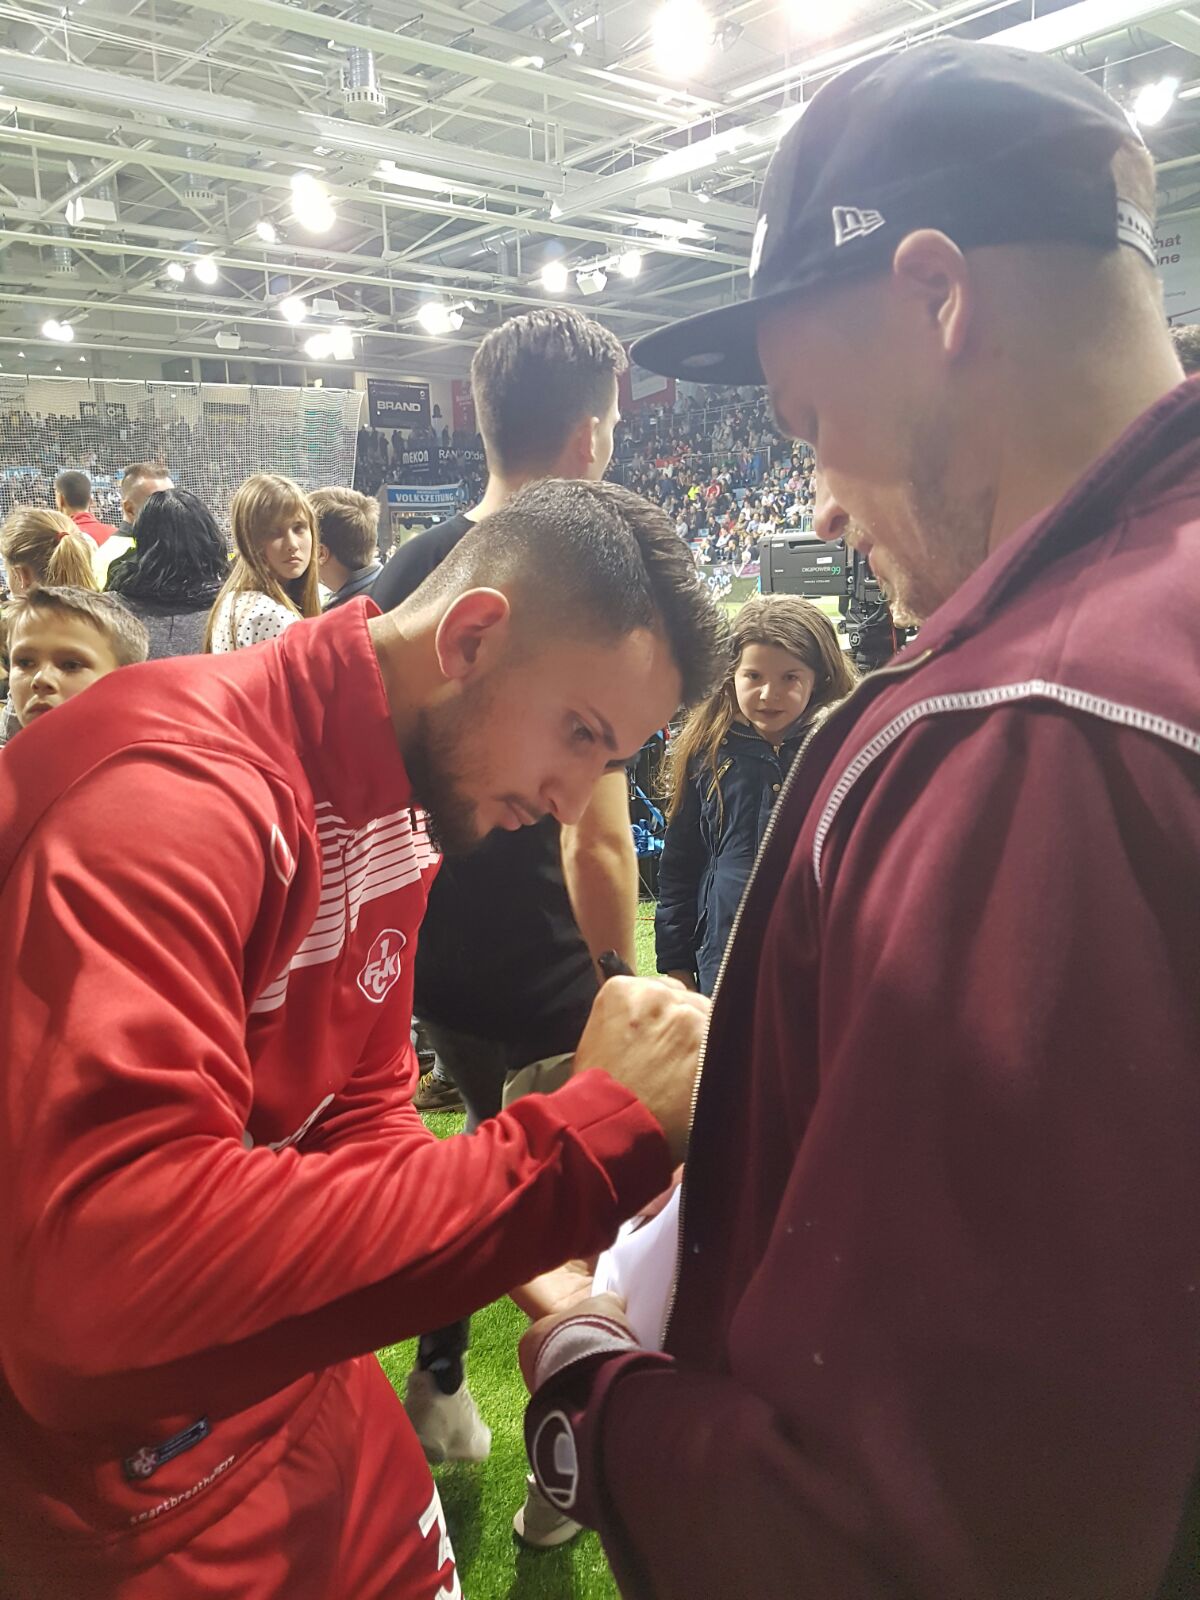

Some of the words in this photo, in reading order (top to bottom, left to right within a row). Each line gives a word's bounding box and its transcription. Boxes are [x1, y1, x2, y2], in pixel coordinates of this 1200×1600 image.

[1156, 253, 1180, 265] ine
[377, 400, 421, 412] BRAND
[395, 492, 455, 503] VOLKSZEITUNG
[831, 566, 841, 576] 99
